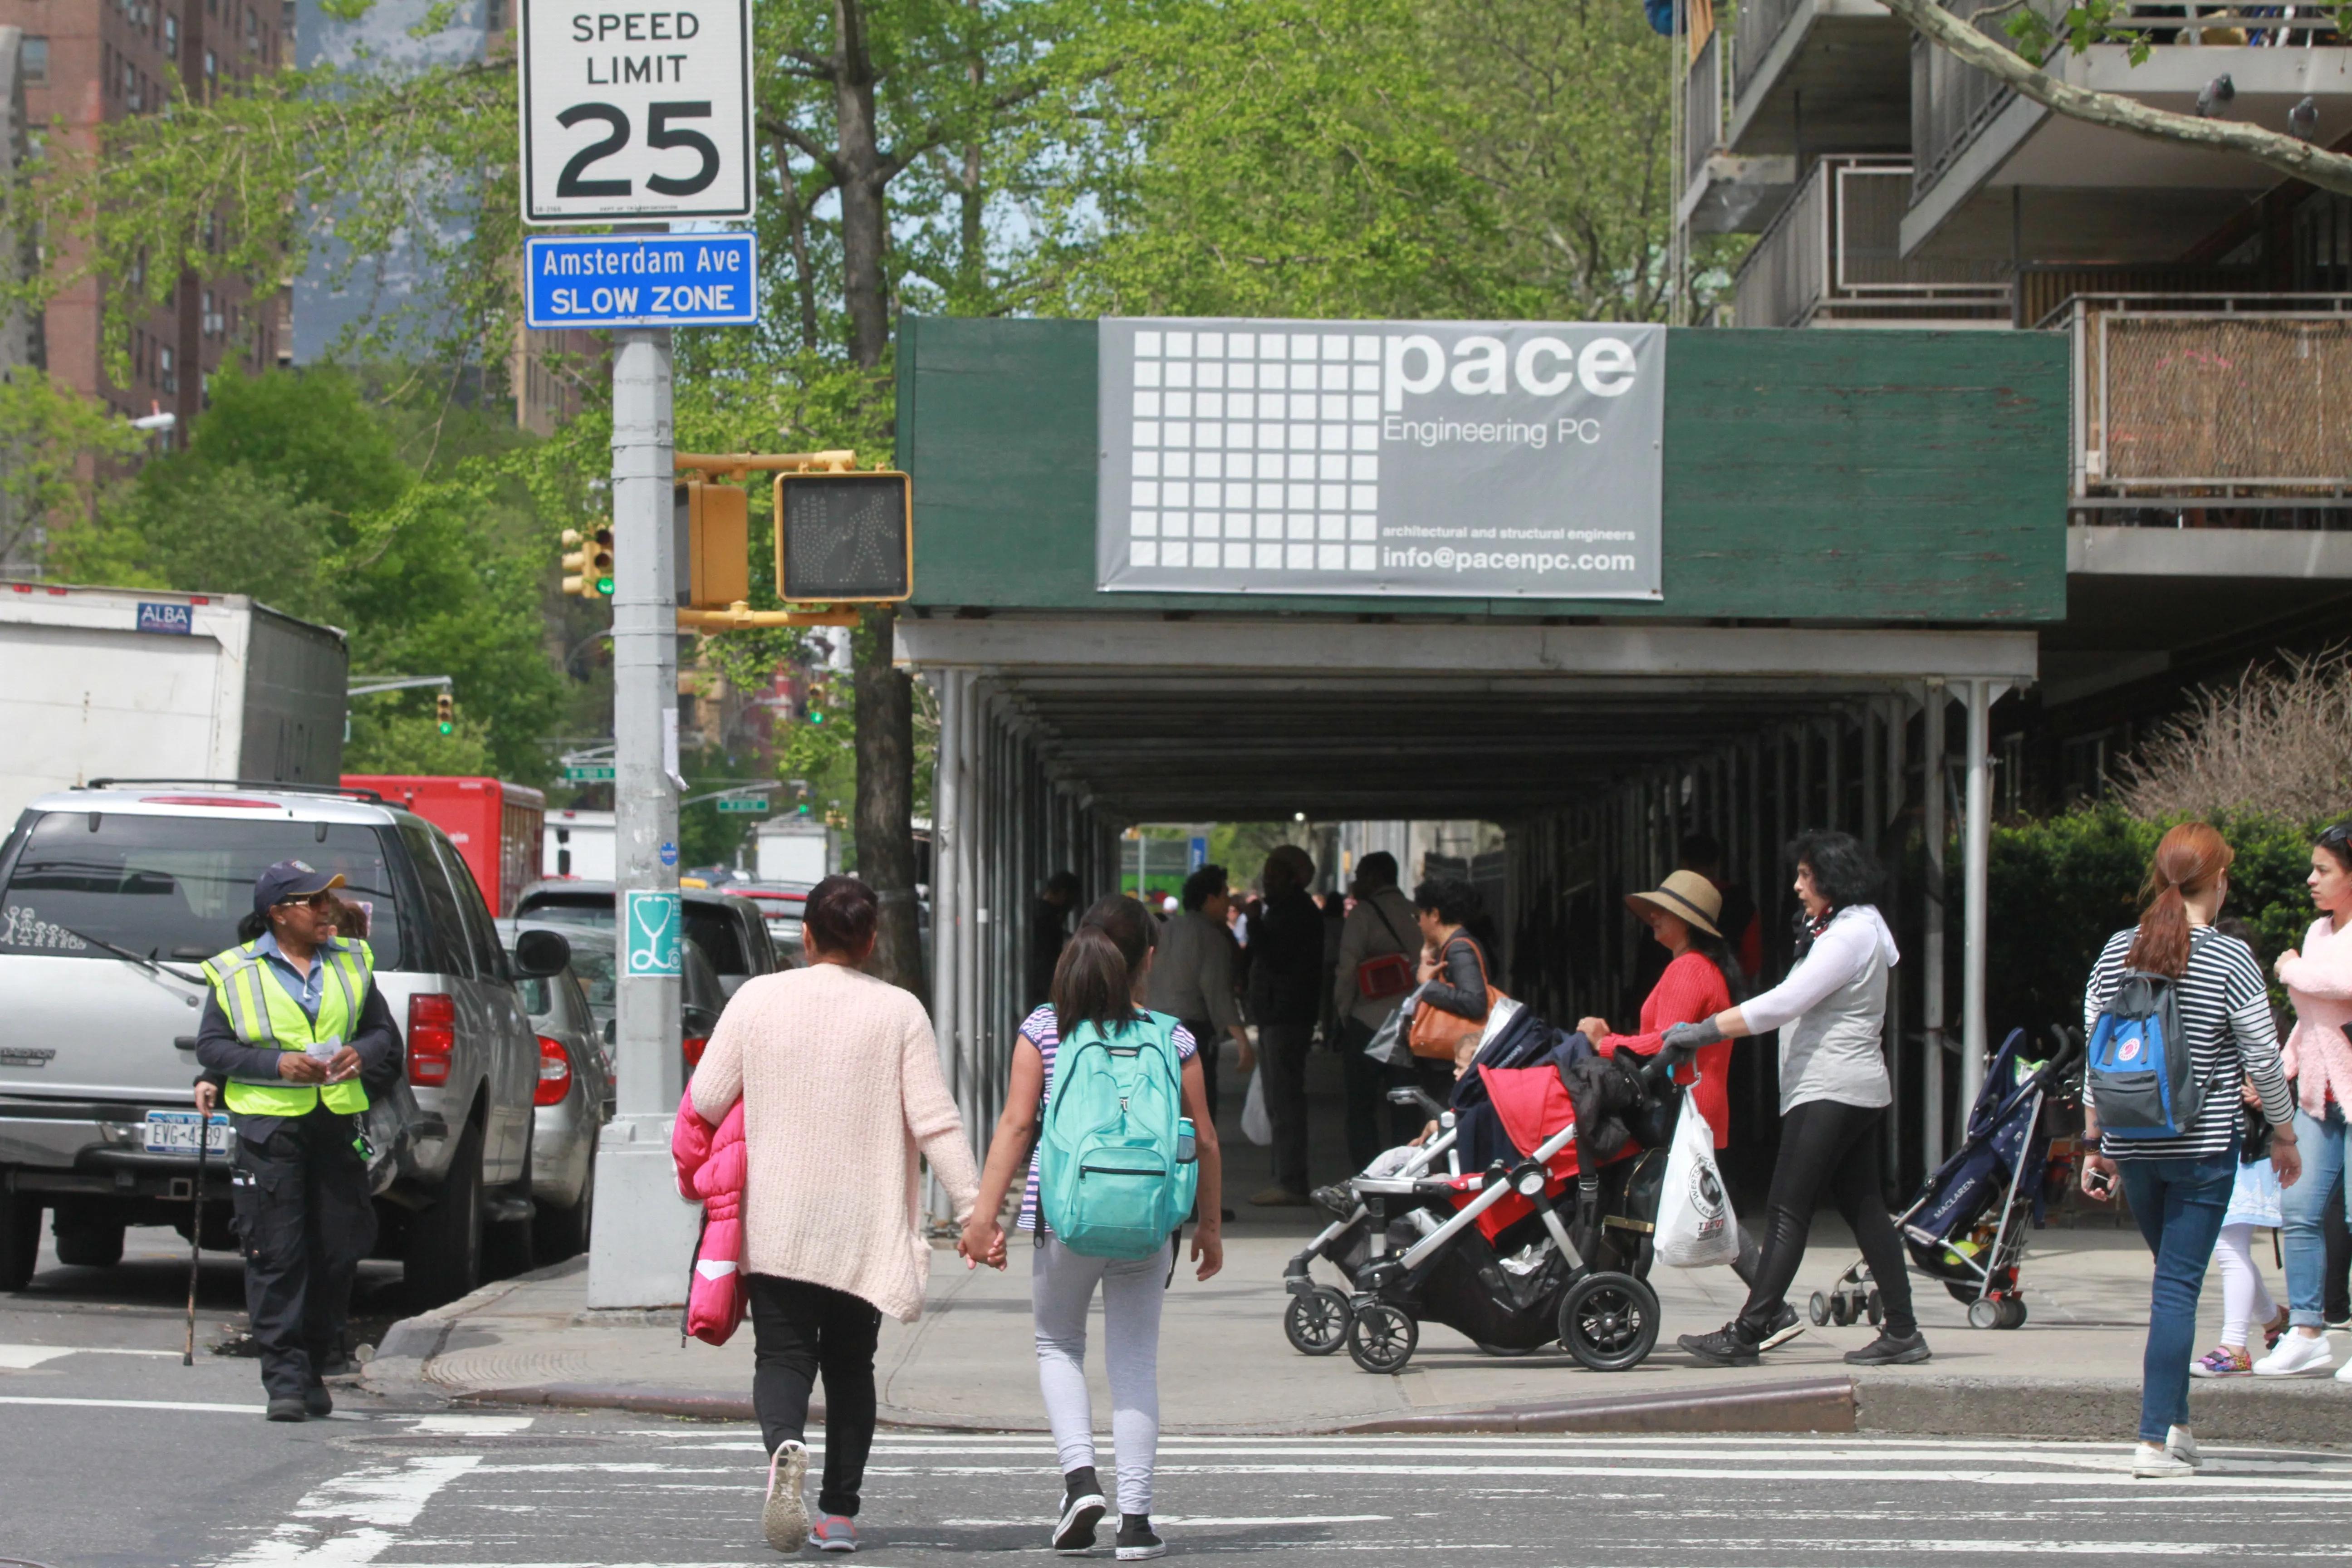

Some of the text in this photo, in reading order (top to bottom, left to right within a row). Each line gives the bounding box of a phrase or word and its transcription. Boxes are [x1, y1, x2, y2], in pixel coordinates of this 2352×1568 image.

[572, 12, 699, 42] SPEED
[588, 55, 687, 85] LIMIT
[555, 100, 720, 198] 25
[544, 245, 740, 276] Amsterdam Ave
[550, 285, 734, 314] SLOW ZONE
[1384, 334, 1636, 411] pace
[1384, 416, 1600, 449] Engineering PC
[1382, 526, 1635, 543] architectural and structural engineers
[1383, 546, 1635, 573] info@pacenpc.com
[141, 605, 187, 623] ALBA
[154, 1125, 177, 1144] EVG
[1934, 1178, 1975, 1219] MACLAREN
